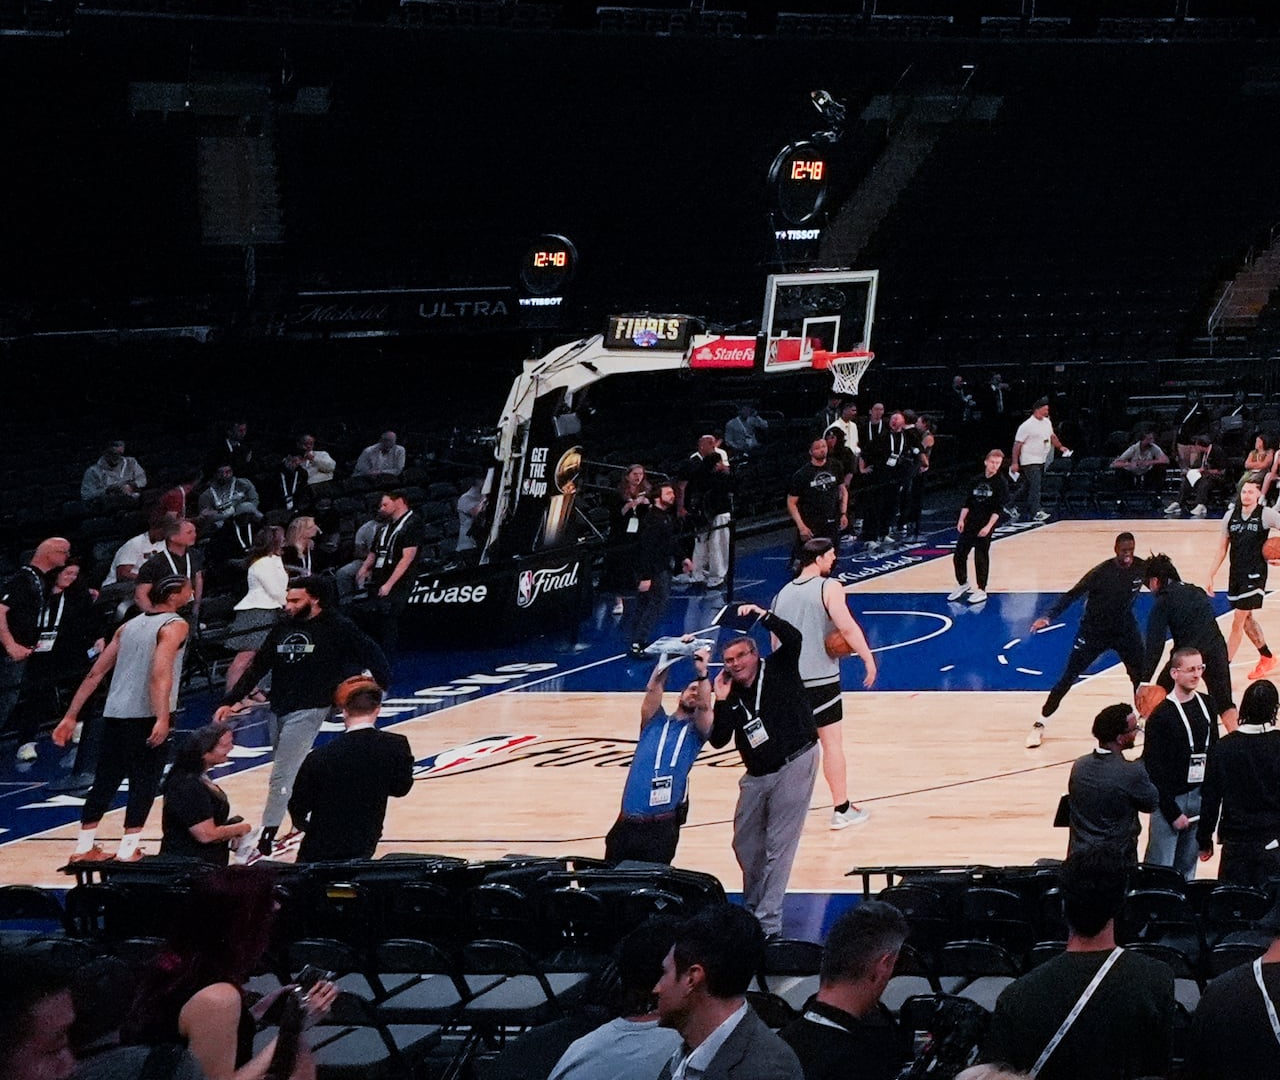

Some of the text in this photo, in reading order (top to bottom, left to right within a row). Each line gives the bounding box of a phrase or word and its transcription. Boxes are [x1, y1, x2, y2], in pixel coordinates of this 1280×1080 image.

[791, 160, 823, 180] 12:48
[787, 229, 820, 241] TISSOT
[533, 252, 566, 267] 12:48
[418, 299, 509, 319] ULTRA
[530, 297, 563, 306] TISSOT
[614, 318, 680, 341] FINALS
[712, 346, 755, 362] StateFa
[531, 448, 549, 463] GET
[529, 463, 547, 478] THE
[530, 481, 547, 498] App
[408, 579, 487, 603] inbase
[524, 562, 580, 608] Final
